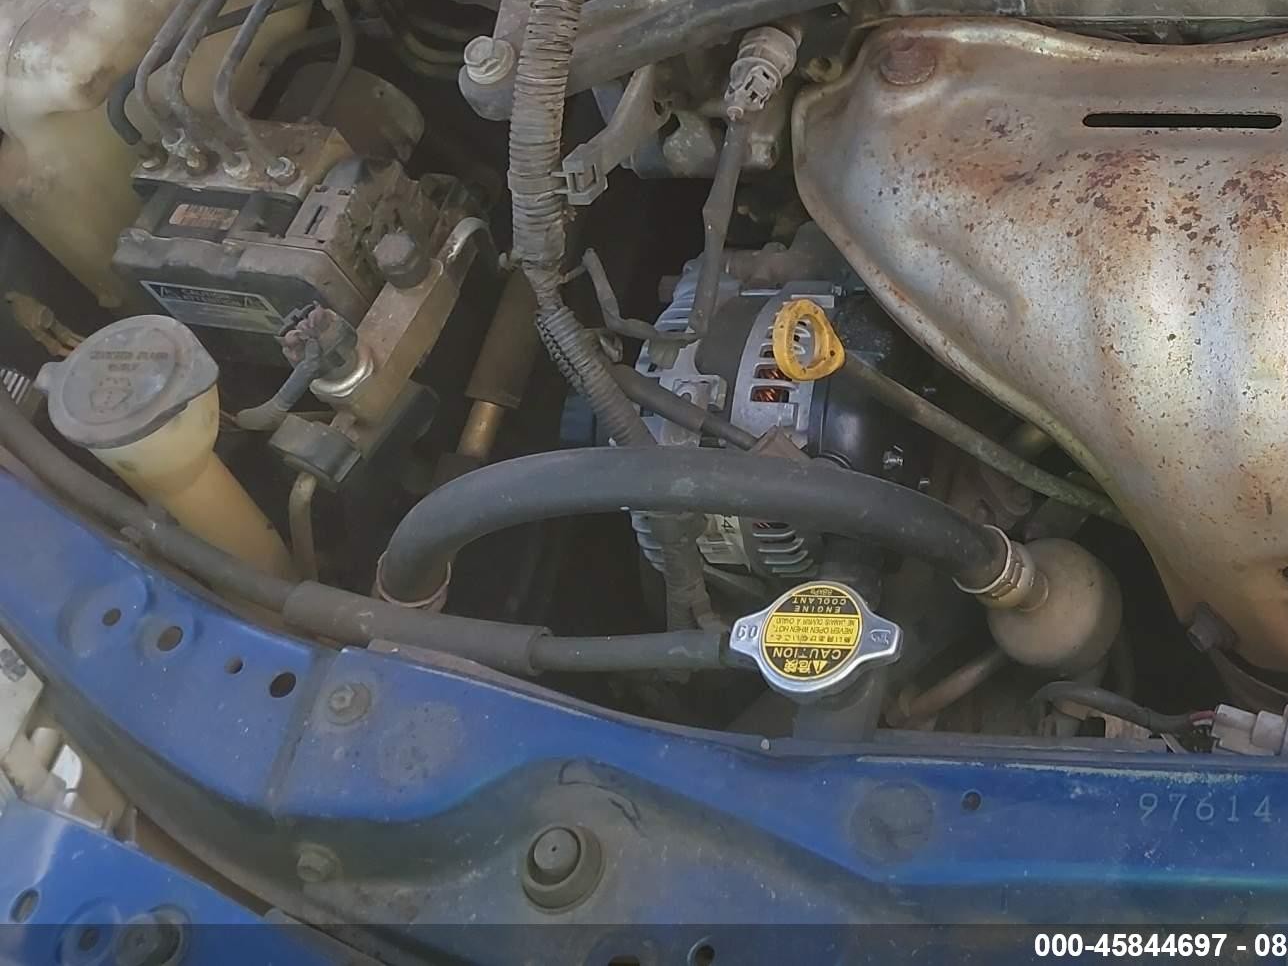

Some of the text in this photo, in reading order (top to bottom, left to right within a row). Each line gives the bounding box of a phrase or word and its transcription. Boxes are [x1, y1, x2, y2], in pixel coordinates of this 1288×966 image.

[792, 597, 847, 605] COOLANT
[794, 605, 841, 613] ENGINE
[810, 626, 829, 634] OPEN
[830, 627, 853, 635] NEVER
[773, 647, 841, 660] CAUTION
[1138, 792, 1273, 822] 97614
